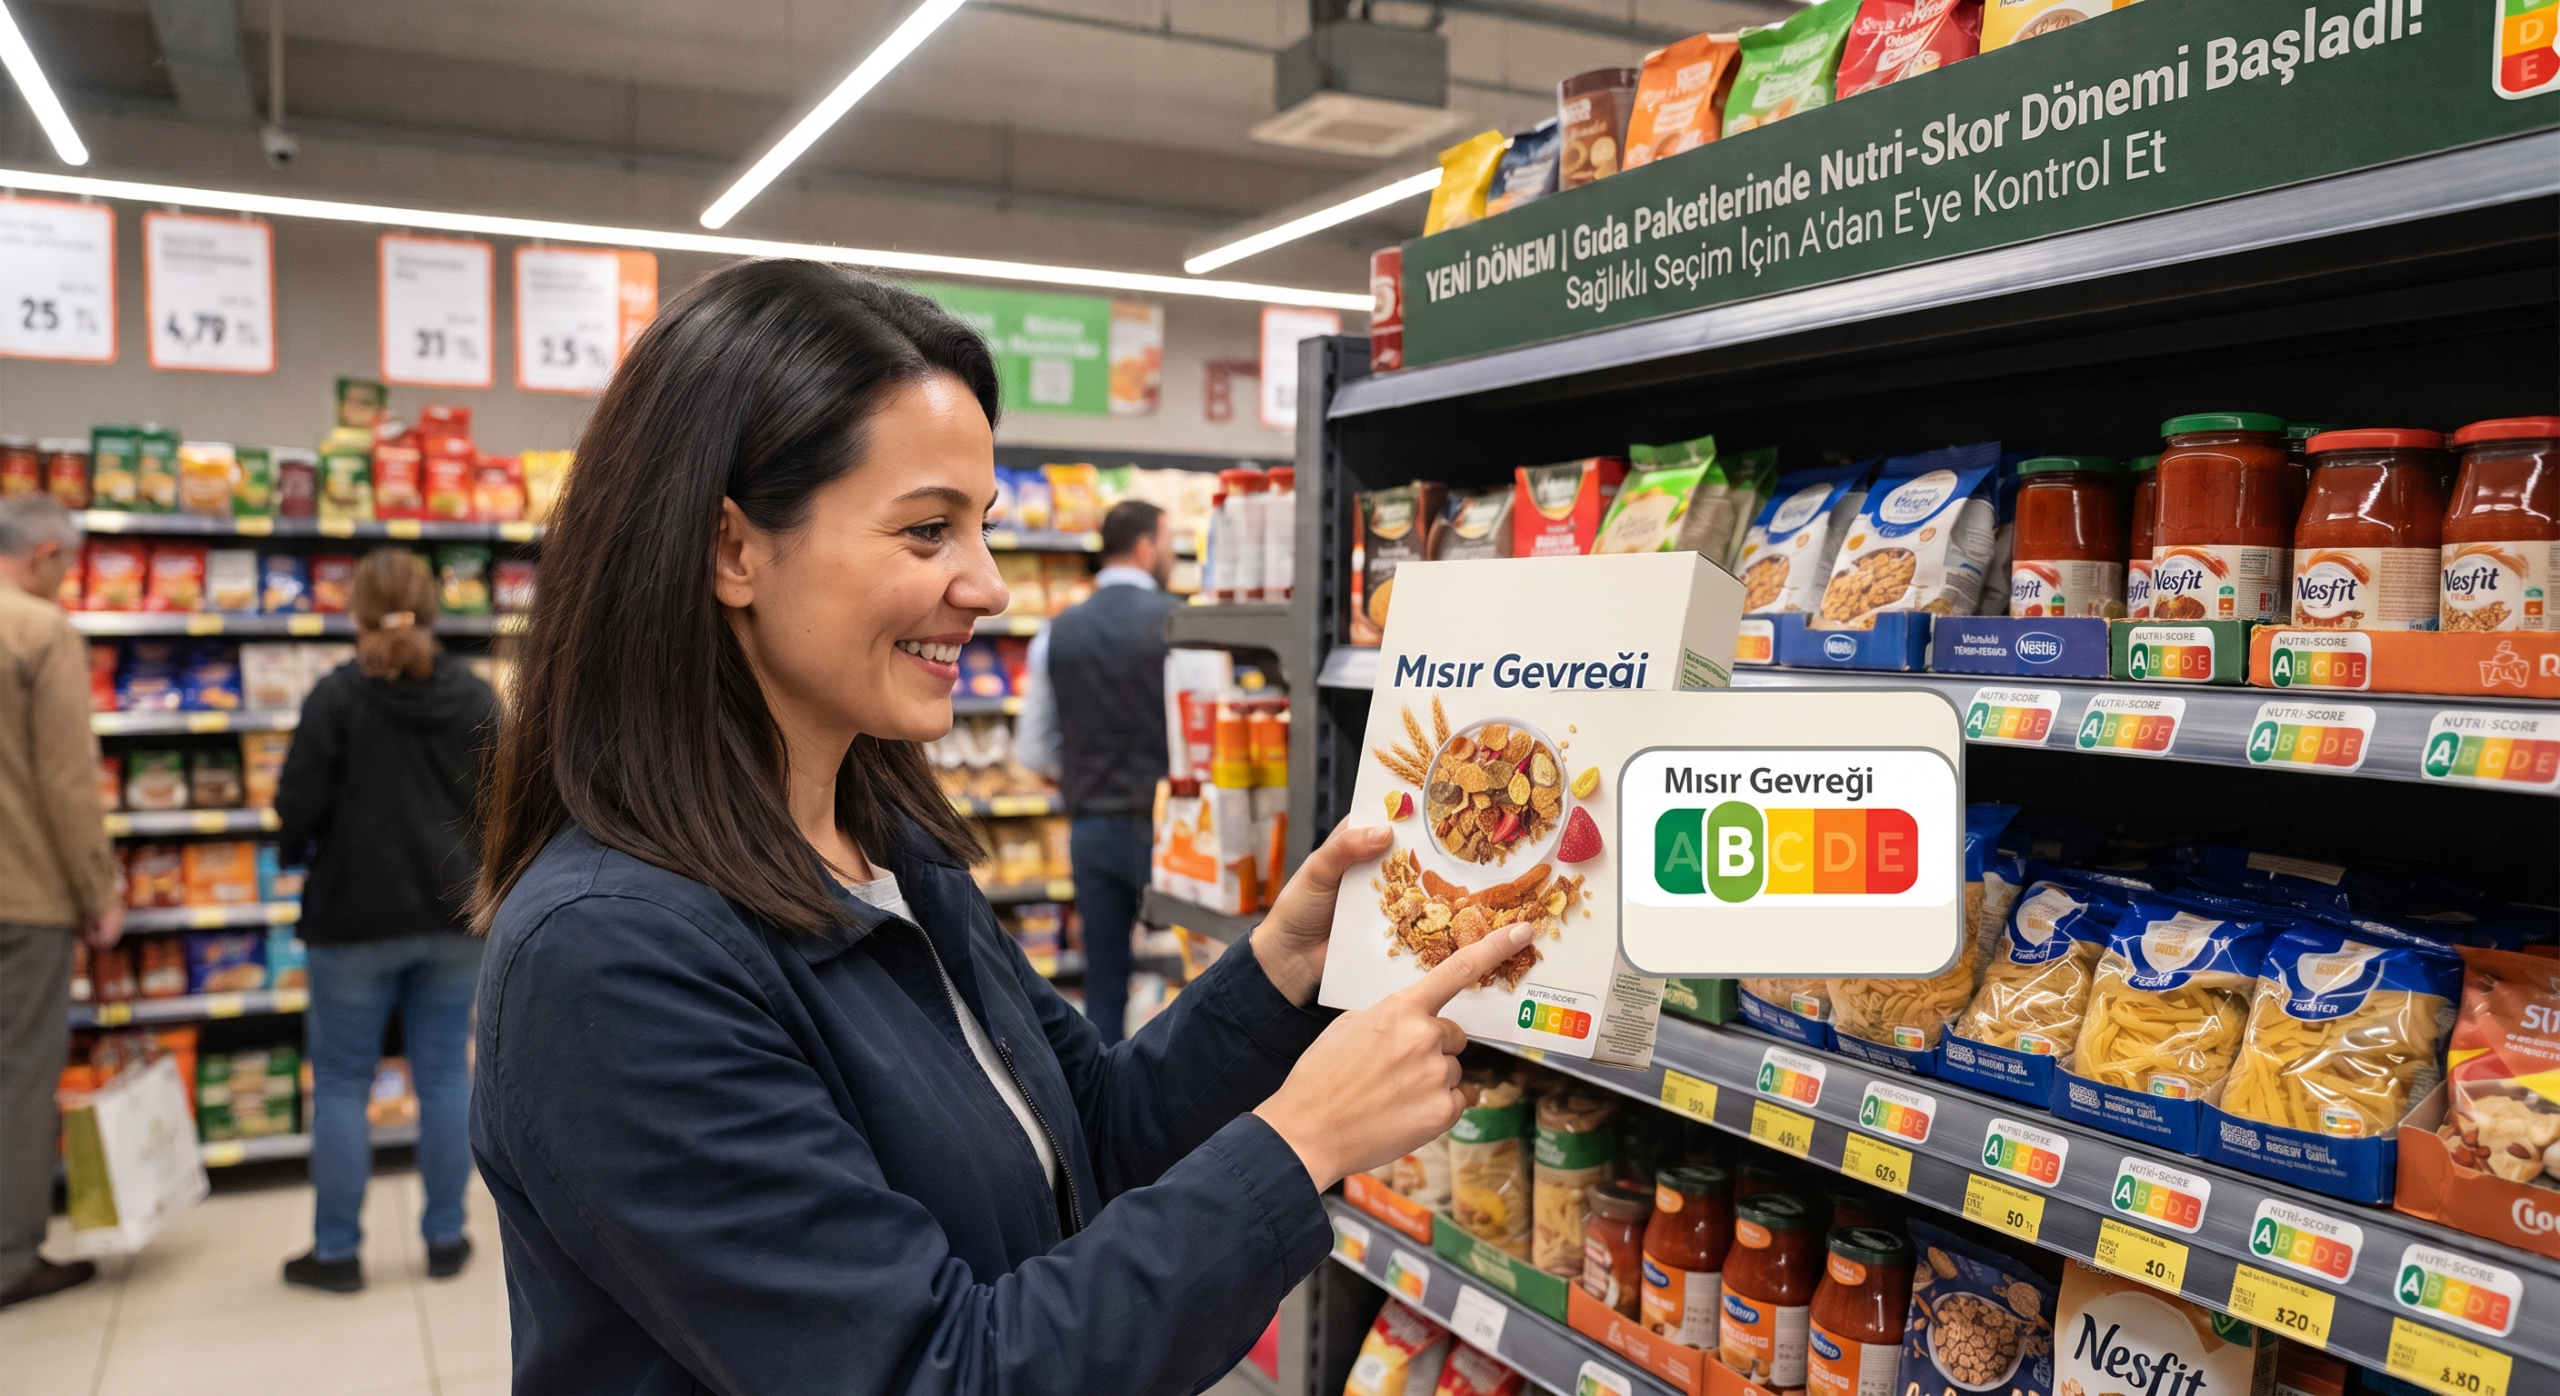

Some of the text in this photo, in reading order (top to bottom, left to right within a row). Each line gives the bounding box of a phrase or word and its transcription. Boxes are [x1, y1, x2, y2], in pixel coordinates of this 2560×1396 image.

[1425, 249, 1471, 304] YENİ
[1476, 229, 1556, 291] DÖNEM
[1574, 215, 1629, 261] Gıda
[1635, 163, 1810, 245] Paketlerinde
[1820, 110, 2009, 196] Nutri-Skor
[2021, 45, 2190, 142] Dönemi
[2205, 0, 2424, 91] Başladı!
[1566, 129, 2167, 313] Sağlıklı Seçim İçin A'dan E'ye Kontrol Et
[21, 298, 60, 331] 25
[2153, 569, 2203, 595] Nesfit
[2297, 577, 2358, 606] Nesfit
[2135, 632, 2196, 642] NUTRI-SCORE
[2278, 637, 2348, 647] NUTRI-SCORE
[1394, 653, 1484, 689] Mısır
[1493, 651, 1651, 690] Gevreği
[1980, 691, 2040, 704] NUTRI-SCORE
[2094, 699, 2161, 711] NUTRI-SCORE
[2266, 708, 2346, 722] NUTRI-SCORE
[2443, 717, 2539, 732] NUTRI-SCORE
[2006, 1209, 2024, 1228] 50
[2270, 1206, 2338, 1236] NUTRI-SCORE
[2415, 1252, 2495, 1284] NUTRI-SCORE
[2074, 1313, 2206, 1396] Nesfit
